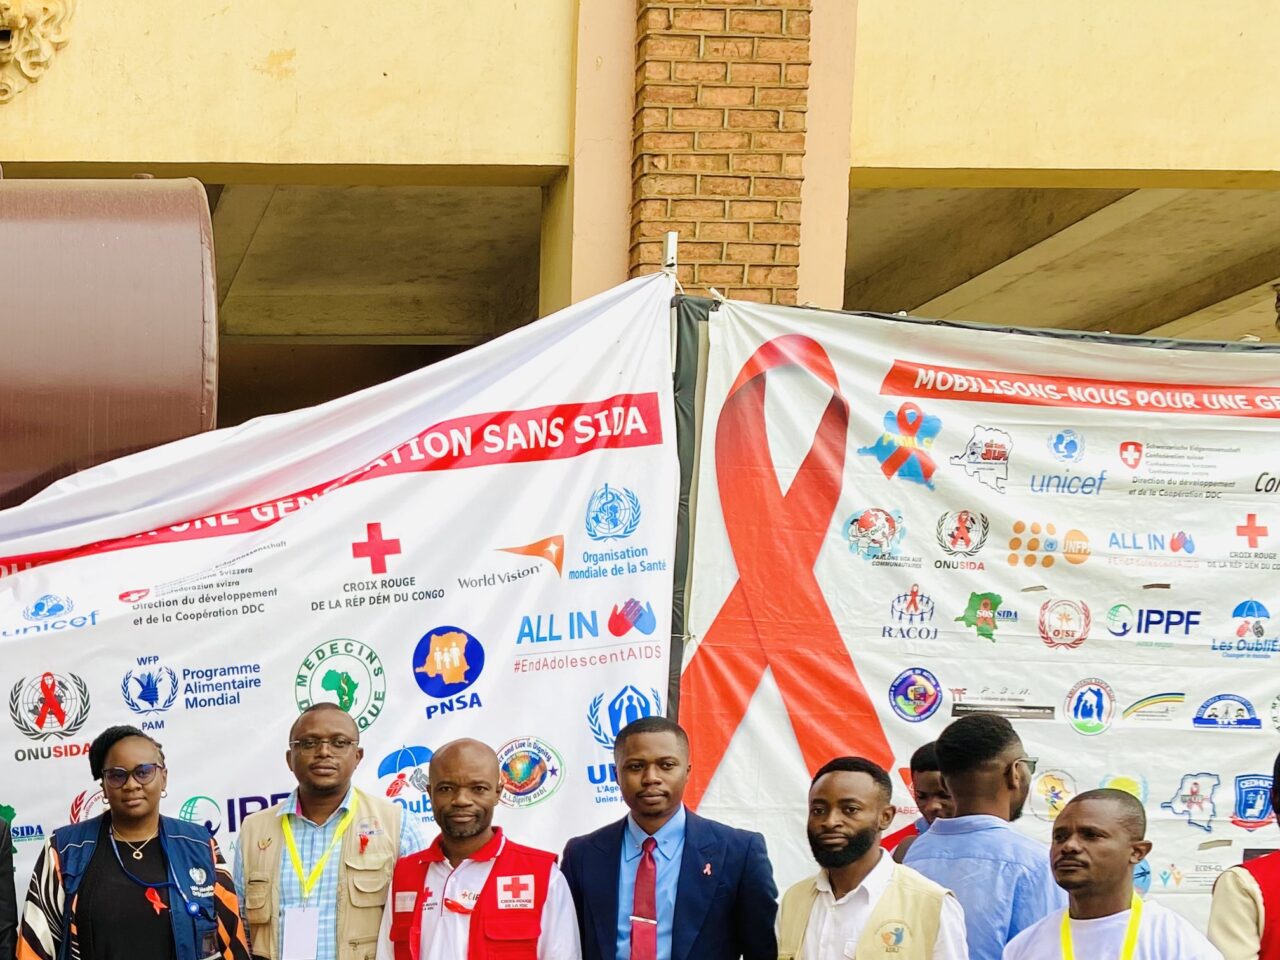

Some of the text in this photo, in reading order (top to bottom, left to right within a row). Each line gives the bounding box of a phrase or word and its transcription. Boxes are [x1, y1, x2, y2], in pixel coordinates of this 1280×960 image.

[915, 368, 1131, 406] MOBILISONS-NOUS
[1136, 390, 1200, 409] POUR
[1203, 394, 1252, 410] UNE
[483, 417, 565, 453] SANS
[575, 406, 648, 442] SIDA
[1030, 468, 1107, 495] unicef
[1108, 532, 1165, 550] ALL IN
[583, 546, 648, 565] Organisation
[934, 560, 985, 570] ONUSIDA
[458, 564, 539, 589] World Vision
[569, 560, 667, 580] mondiale de la Santé
[343, 577, 416, 592] CROIX ROUGE
[181, 593, 195, 606] du
[198, 588, 277, 604] développement
[311, 589, 445, 611] DE LA RÉP DÉM DU CONGO
[2, 610, 100, 637] unicef
[133, 603, 265, 625] et de la Coopération DDC
[975, 610, 1018, 619] SOS SIDA
[1136, 609, 1202, 635] IPPF
[516, 610, 599, 645] ALL IN
[881, 625, 939, 640] RACOJ
[1211, 639, 1233, 650] Les
[136, 656, 159, 666] WFP
[296, 641, 384, 687] MEDECINS
[514, 645, 662, 673] #EndAdolescentAIDS
[182, 663, 261, 681] Programme
[184, 677, 262, 695] Alimentaire
[185, 691, 241, 709] Mondial
[426, 692, 482, 719] PNSA
[141, 720, 165, 731] PAM
[14, 742, 91, 762] ONUSIDA
[11, 824, 44, 837] SIDA
